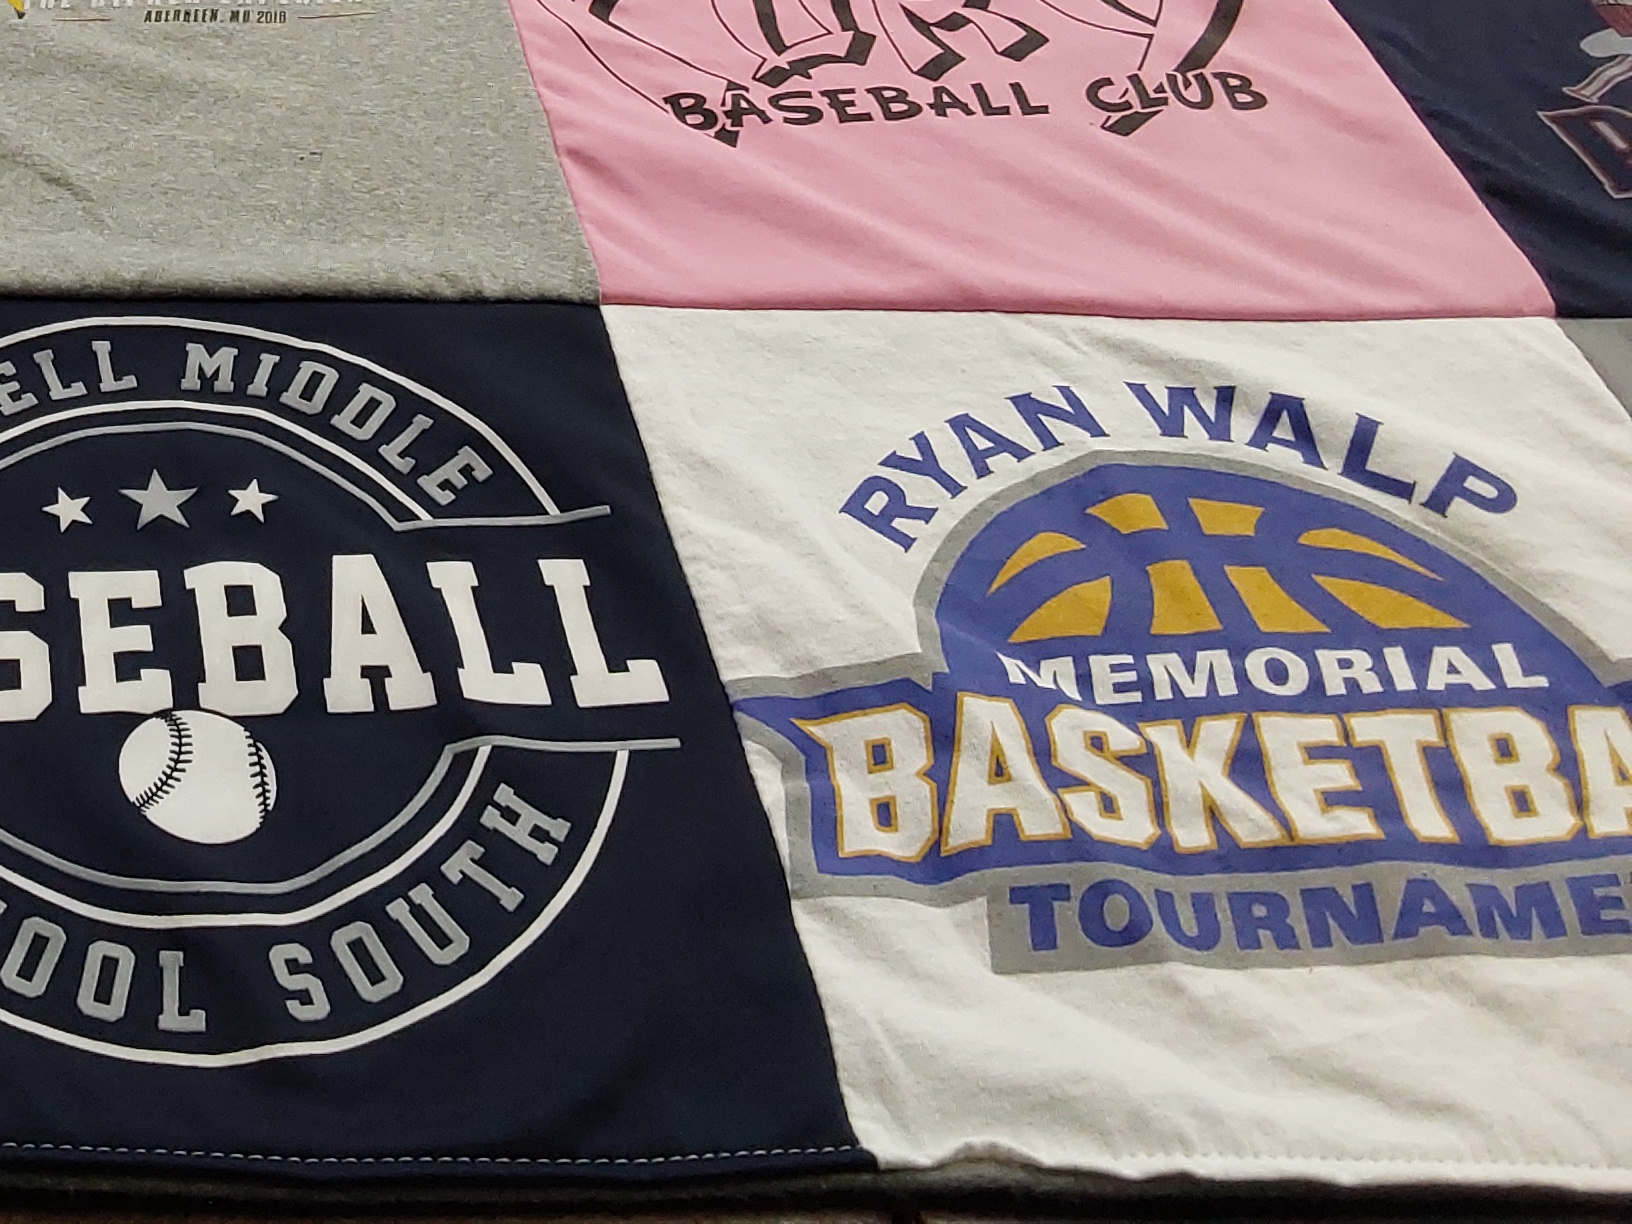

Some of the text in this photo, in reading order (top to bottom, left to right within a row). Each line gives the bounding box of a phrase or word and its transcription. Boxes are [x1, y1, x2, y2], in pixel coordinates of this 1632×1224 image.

[663, 67, 1270, 135] BASEBALL CLUB
[181, 341, 494, 508] MIDDLE
[838, 381, 1519, 554] RYAN WALP
[995, 642, 1550, 707] MEMORIAL
[268, 781, 572, 1023] SOUTH
